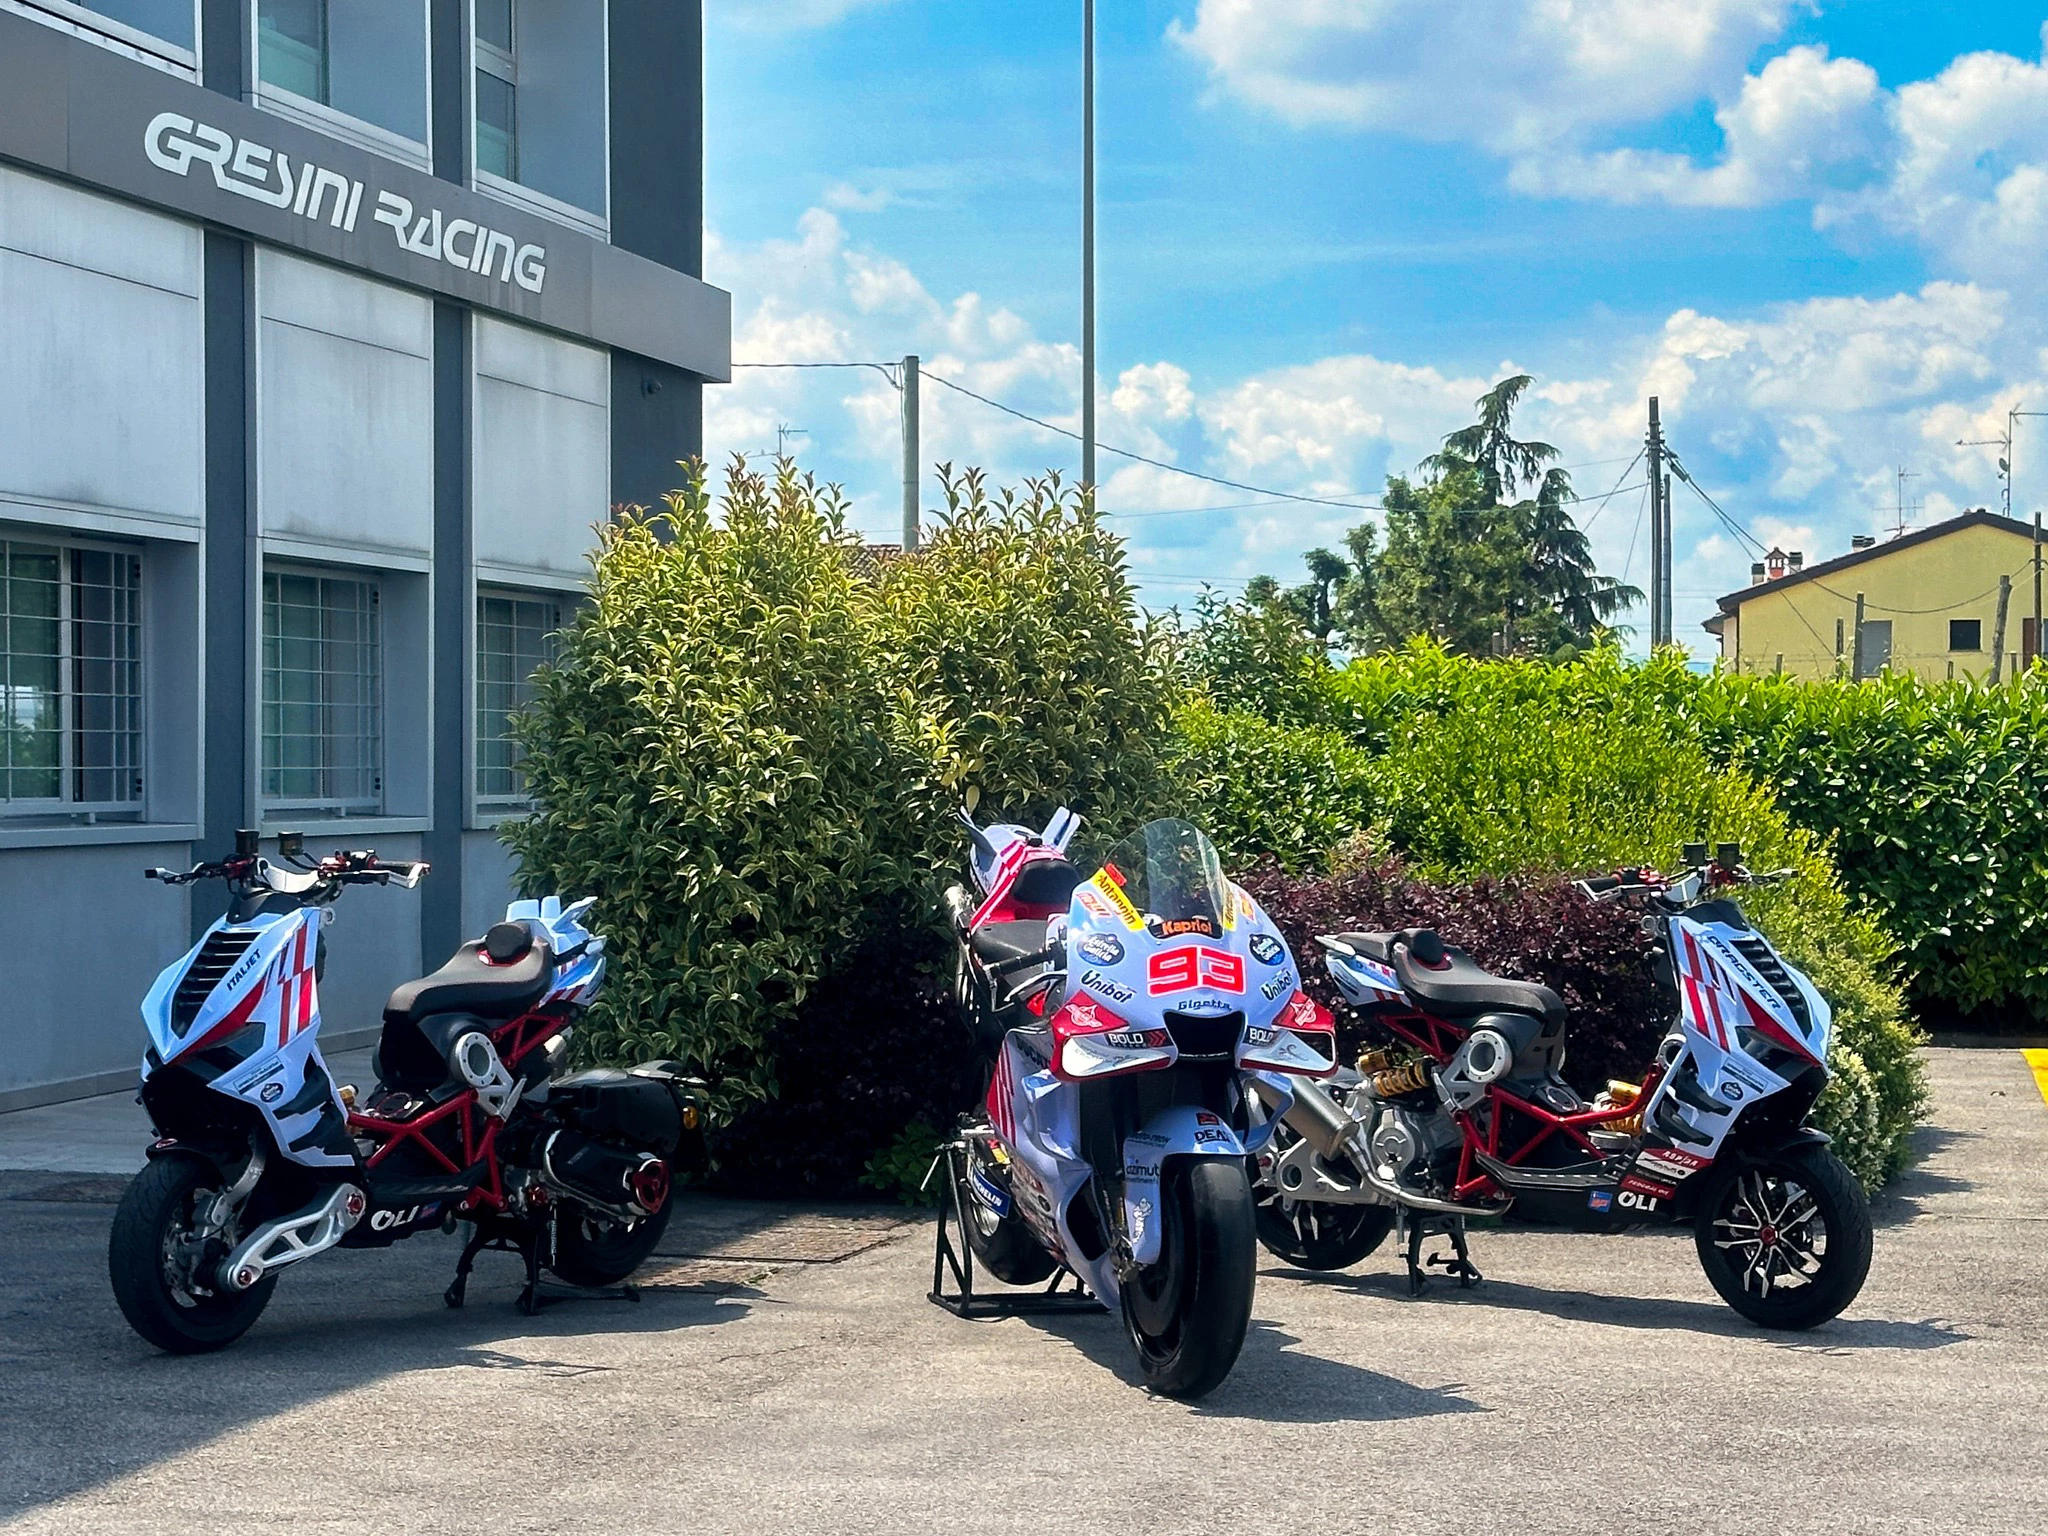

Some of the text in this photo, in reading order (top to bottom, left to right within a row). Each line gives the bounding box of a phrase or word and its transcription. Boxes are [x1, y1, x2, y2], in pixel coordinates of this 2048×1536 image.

[144, 112, 547, 294] GRESINI RACING
[1161, 919, 1213, 936] Kapriol
[226, 948, 261, 991] ITALJET
[1147, 944, 1247, 998] 93
[1707, 936, 1781, 1009] DRAGSTER
[1081, 970, 1133, 1003] Unibat
[1260, 970, 1293, 1001] Unibat
[1108, 1033, 1144, 1044] BOLD
[1249, 1028, 1274, 1042] BOLD
[1126, 1159, 1160, 1177] azimut
[1617, 1191, 1658, 1212] OLI
[371, 1205, 420, 1231] OLI
